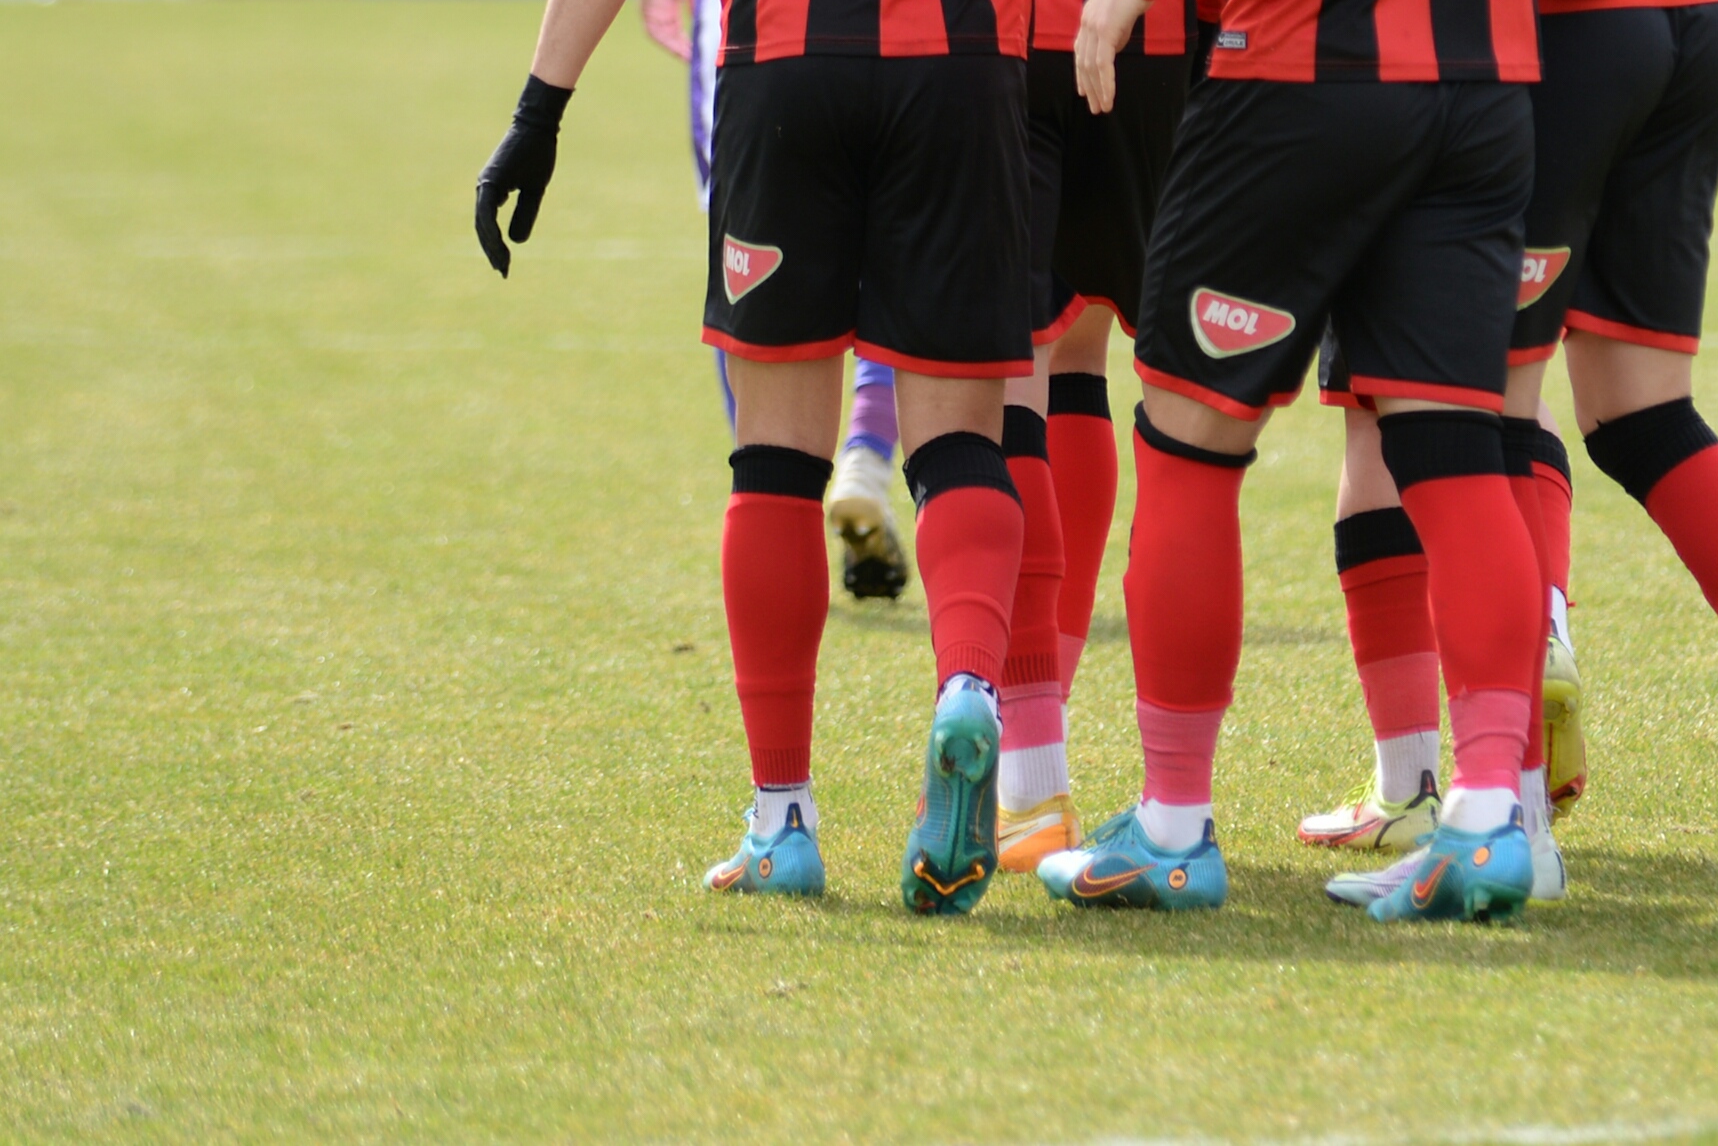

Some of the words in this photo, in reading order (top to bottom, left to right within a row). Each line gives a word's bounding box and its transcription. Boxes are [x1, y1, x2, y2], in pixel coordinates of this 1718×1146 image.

[726, 245, 750, 276] MOL
[1521, 258, 1547, 283] OL
[1203, 300, 1259, 335] MOL
